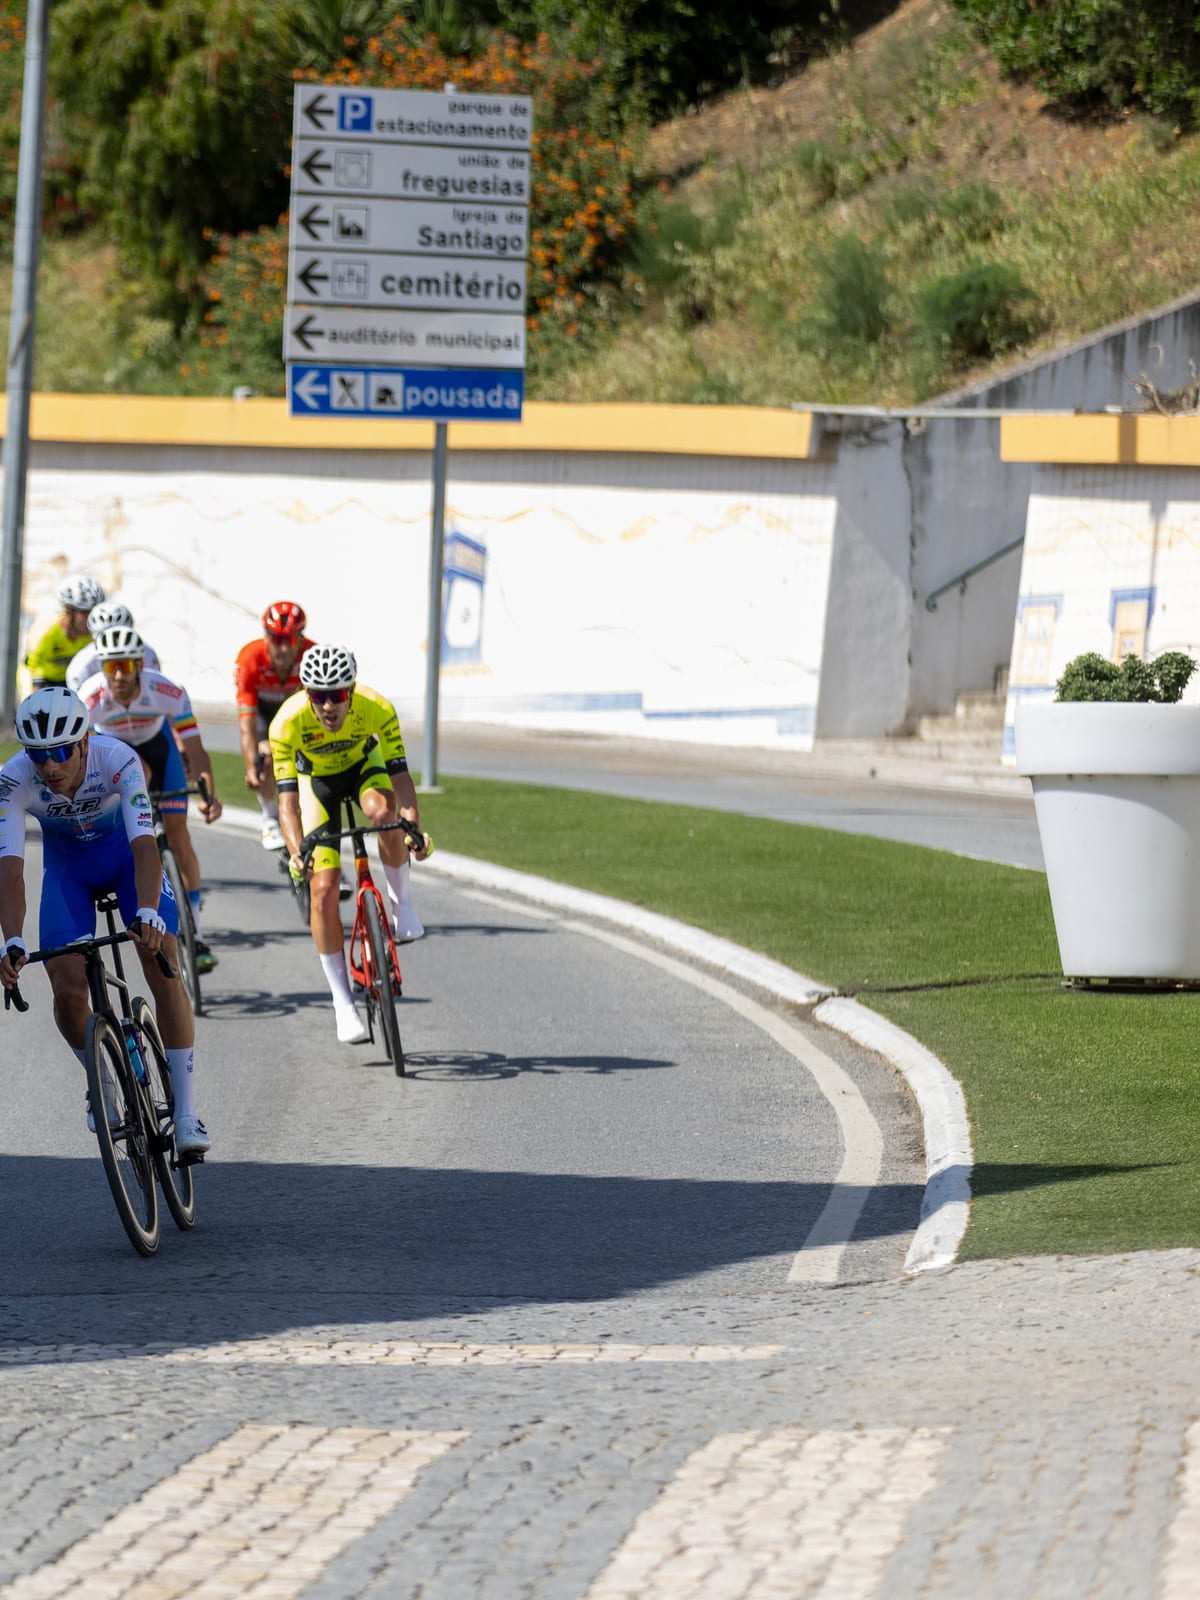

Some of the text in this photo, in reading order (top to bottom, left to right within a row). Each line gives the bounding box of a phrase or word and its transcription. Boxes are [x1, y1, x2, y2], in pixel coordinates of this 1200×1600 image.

[448, 100, 529, 117] parque de
[376, 117, 528, 140] estacionamento
[458, 153, 526, 170] união de
[402, 171, 525, 198] freguesias
[505, 211, 524, 224] de
[418, 226, 523, 254] Santiago
[380, 271, 522, 301] cemitério
[327, 324, 520, 351] auditório municipal
[405, 382, 520, 411] pousada
